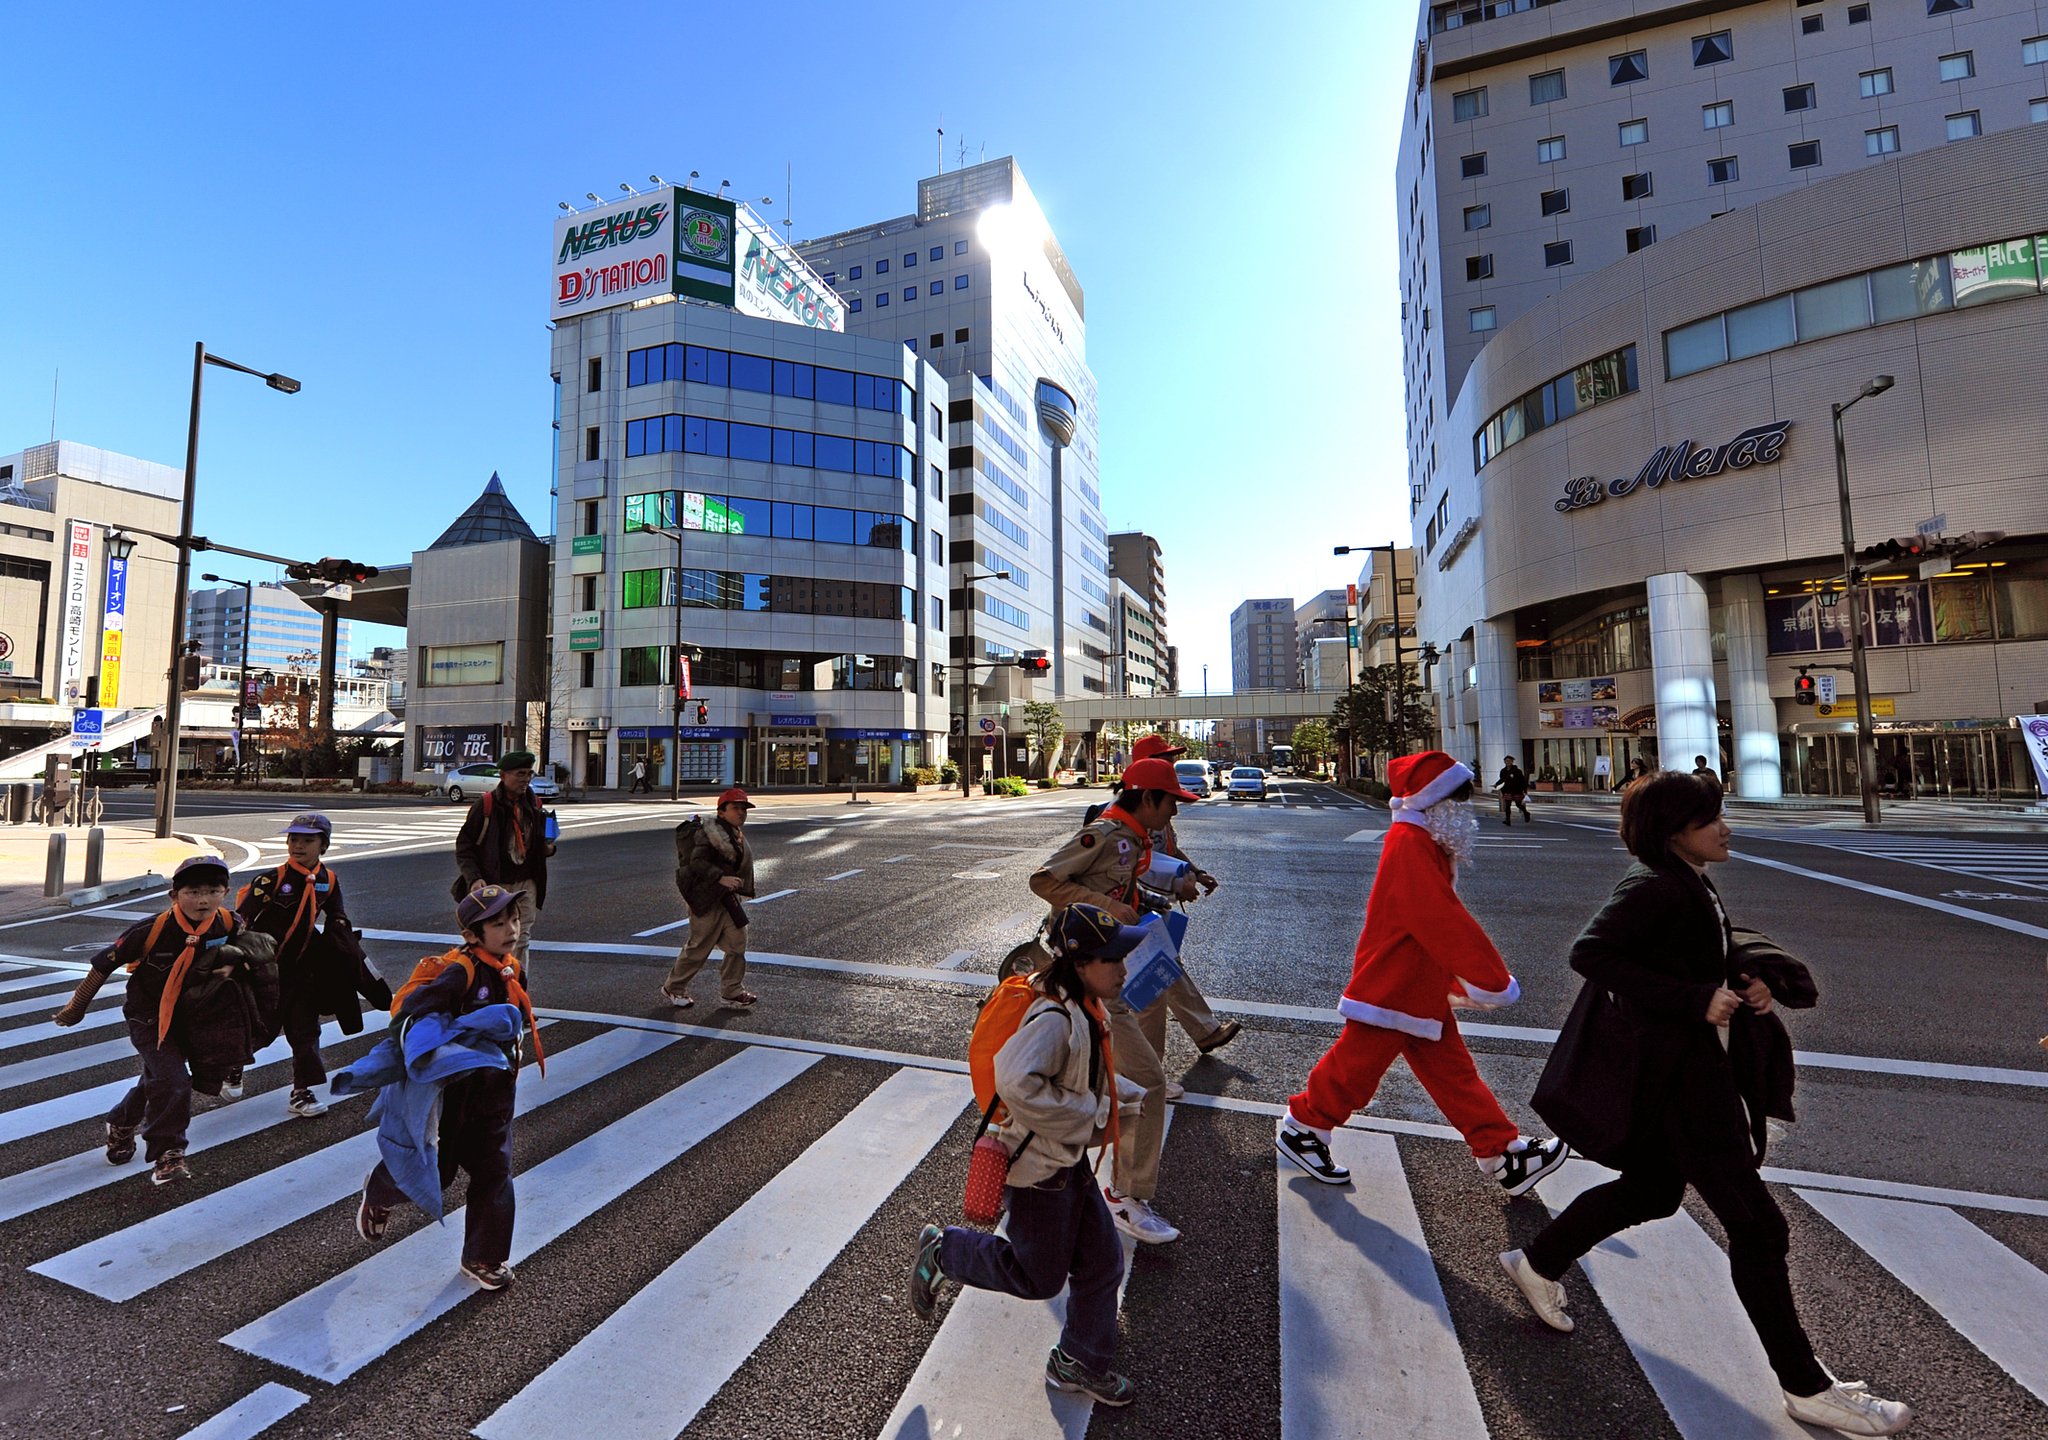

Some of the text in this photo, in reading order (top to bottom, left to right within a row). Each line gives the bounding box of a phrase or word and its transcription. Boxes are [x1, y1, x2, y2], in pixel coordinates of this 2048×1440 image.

[558, 203, 669, 265] NEXUS
[741, 233, 842, 333] NEXUS
[1554, 419, 1793, 513] La Merce
[72, 562, 84, 601] ユニクロ
[76, 711, 86, 722] P
[425, 741, 455, 757] TBC
[463, 741, 490, 757] TBC
[467, 733, 487, 741] MEN'S
